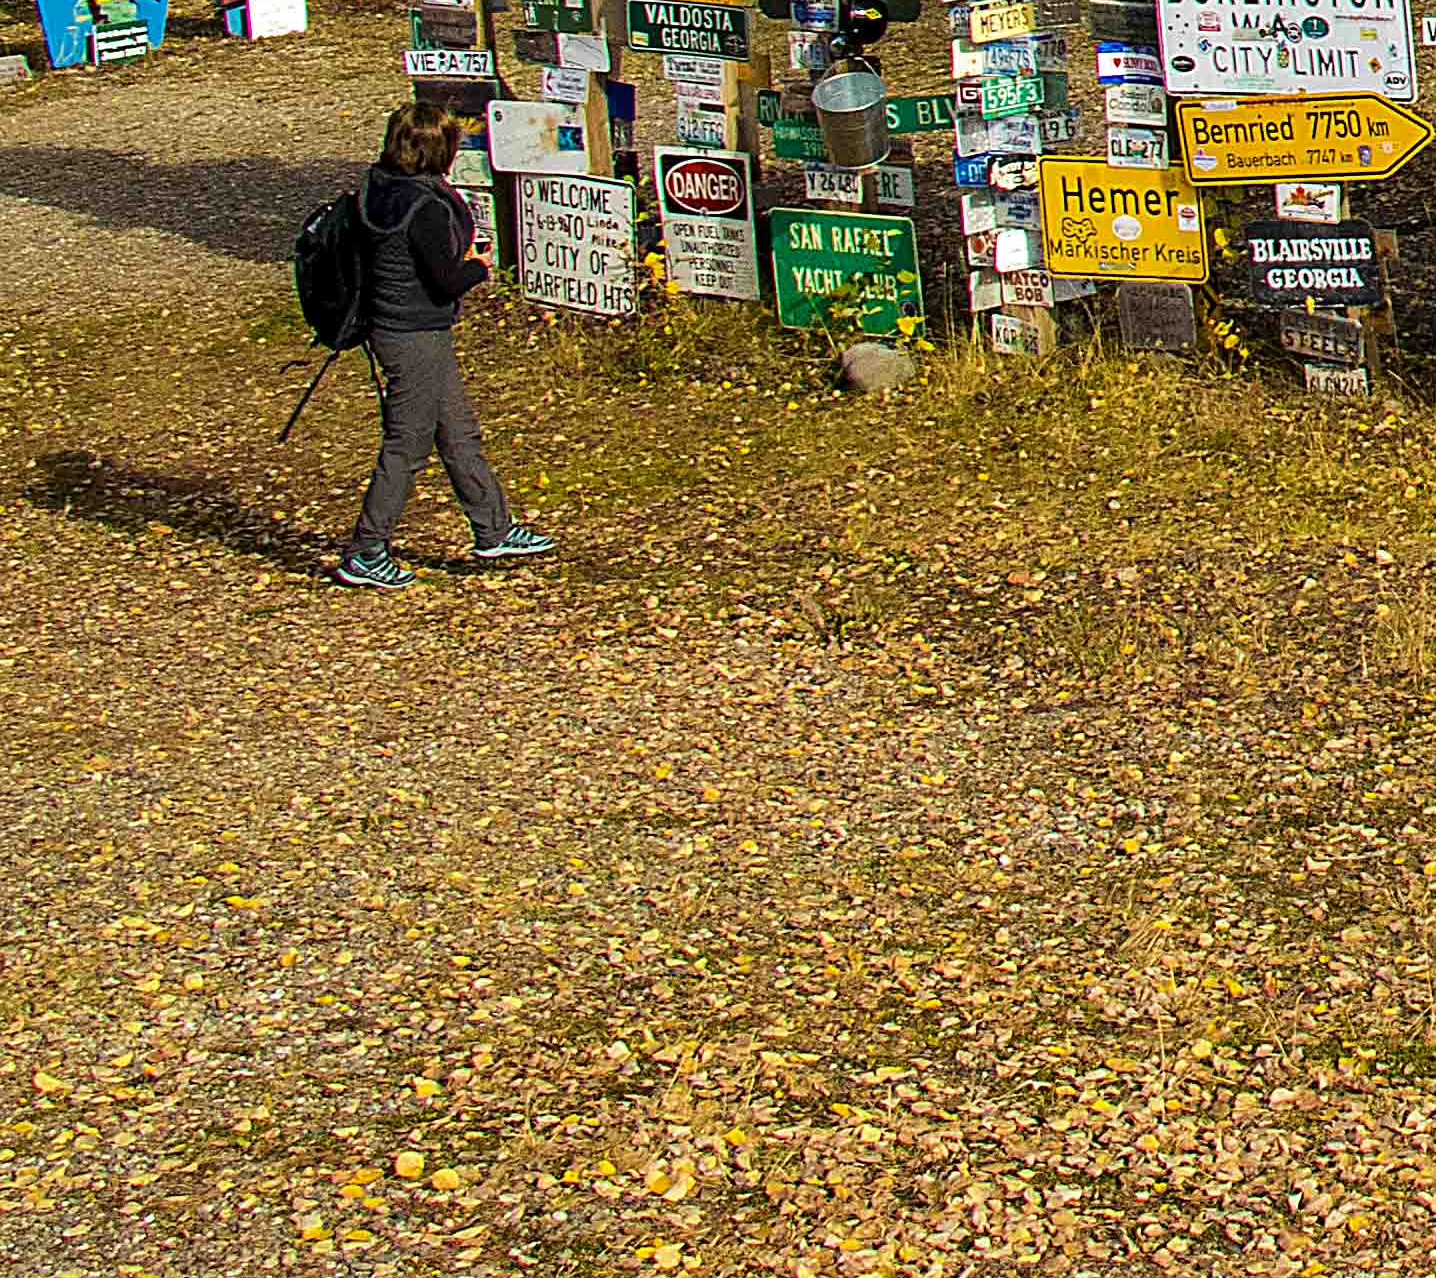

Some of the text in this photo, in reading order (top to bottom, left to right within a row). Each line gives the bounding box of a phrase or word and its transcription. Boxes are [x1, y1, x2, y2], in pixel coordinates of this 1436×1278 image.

[643, 4, 733, 30] VALDOSTA
[662, 27, 722, 52] GEORGIA
[1213, 45, 1359, 78] CITY LIMIT
[1192, 110, 1390, 147] Bernried 7750 km
[538, 180, 612, 215] WELCOME
[672, 169, 738, 201] DANGER
[1062, 176, 1178, 216] Hemer
[545, 243, 610, 275] CITY OF
[1251, 237, 1372, 263] BLAIRSVILLE
[526, 268, 635, 312] GARFIELD HTS
[1267, 267, 1364, 291] GEORGIA
